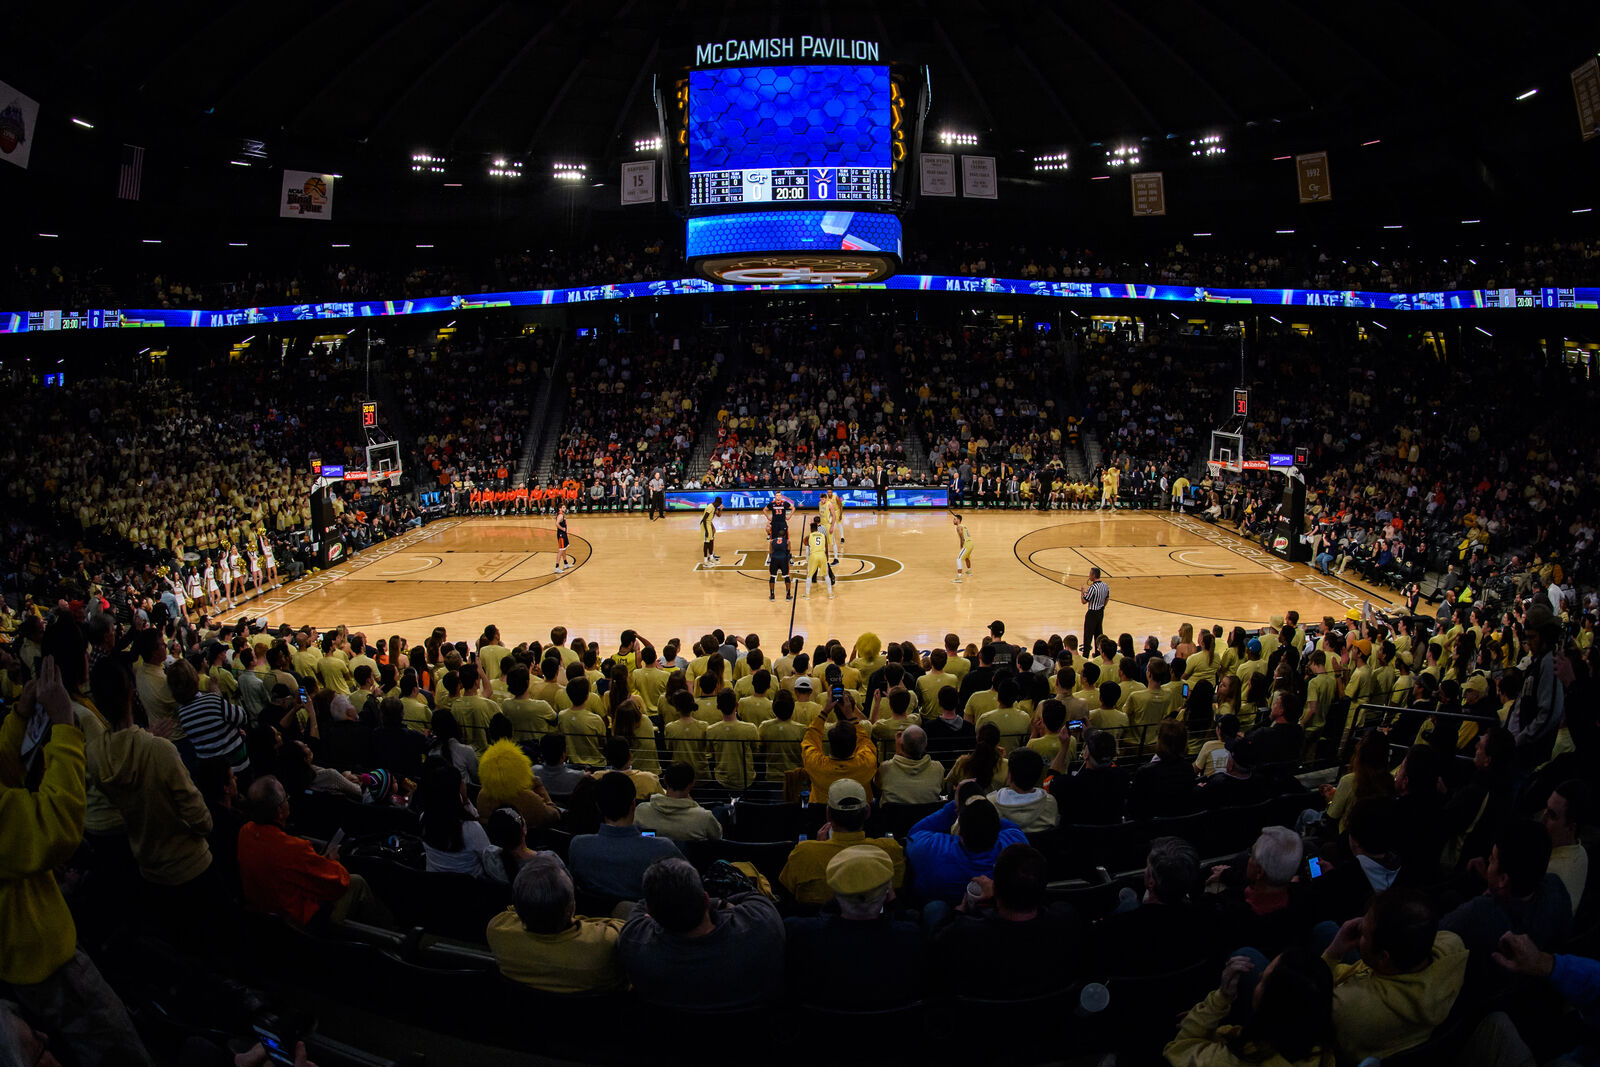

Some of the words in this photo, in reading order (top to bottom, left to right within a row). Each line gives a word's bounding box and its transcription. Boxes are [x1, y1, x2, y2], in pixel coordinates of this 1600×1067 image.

[801, 35, 879, 62] PAVILION
[633, 175, 644, 187] 15
[747, 172, 768, 184] GT
[795, 177, 804, 185] 30
[753, 184, 762, 200] 0
[776, 188, 804, 199] 20:00
[818, 183, 828, 198] 0
[1505, 296, 1509, 306] 0
[1517, 298, 1532, 306] 20:00
[1548, 296, 1552, 306] 0
[49, 318, 54, 328] 0
[62, 320, 78, 329] 20:00
[93, 316, 98, 328] 0
[363, 405, 374, 413] 20:00
[1238, 400, 1246, 413] 30
[365, 413, 373, 425] 30
[816, 537, 821, 546] 5
[221, 569, 350, 625] ELLOW
[1294, 575, 1387, 616] TEC
